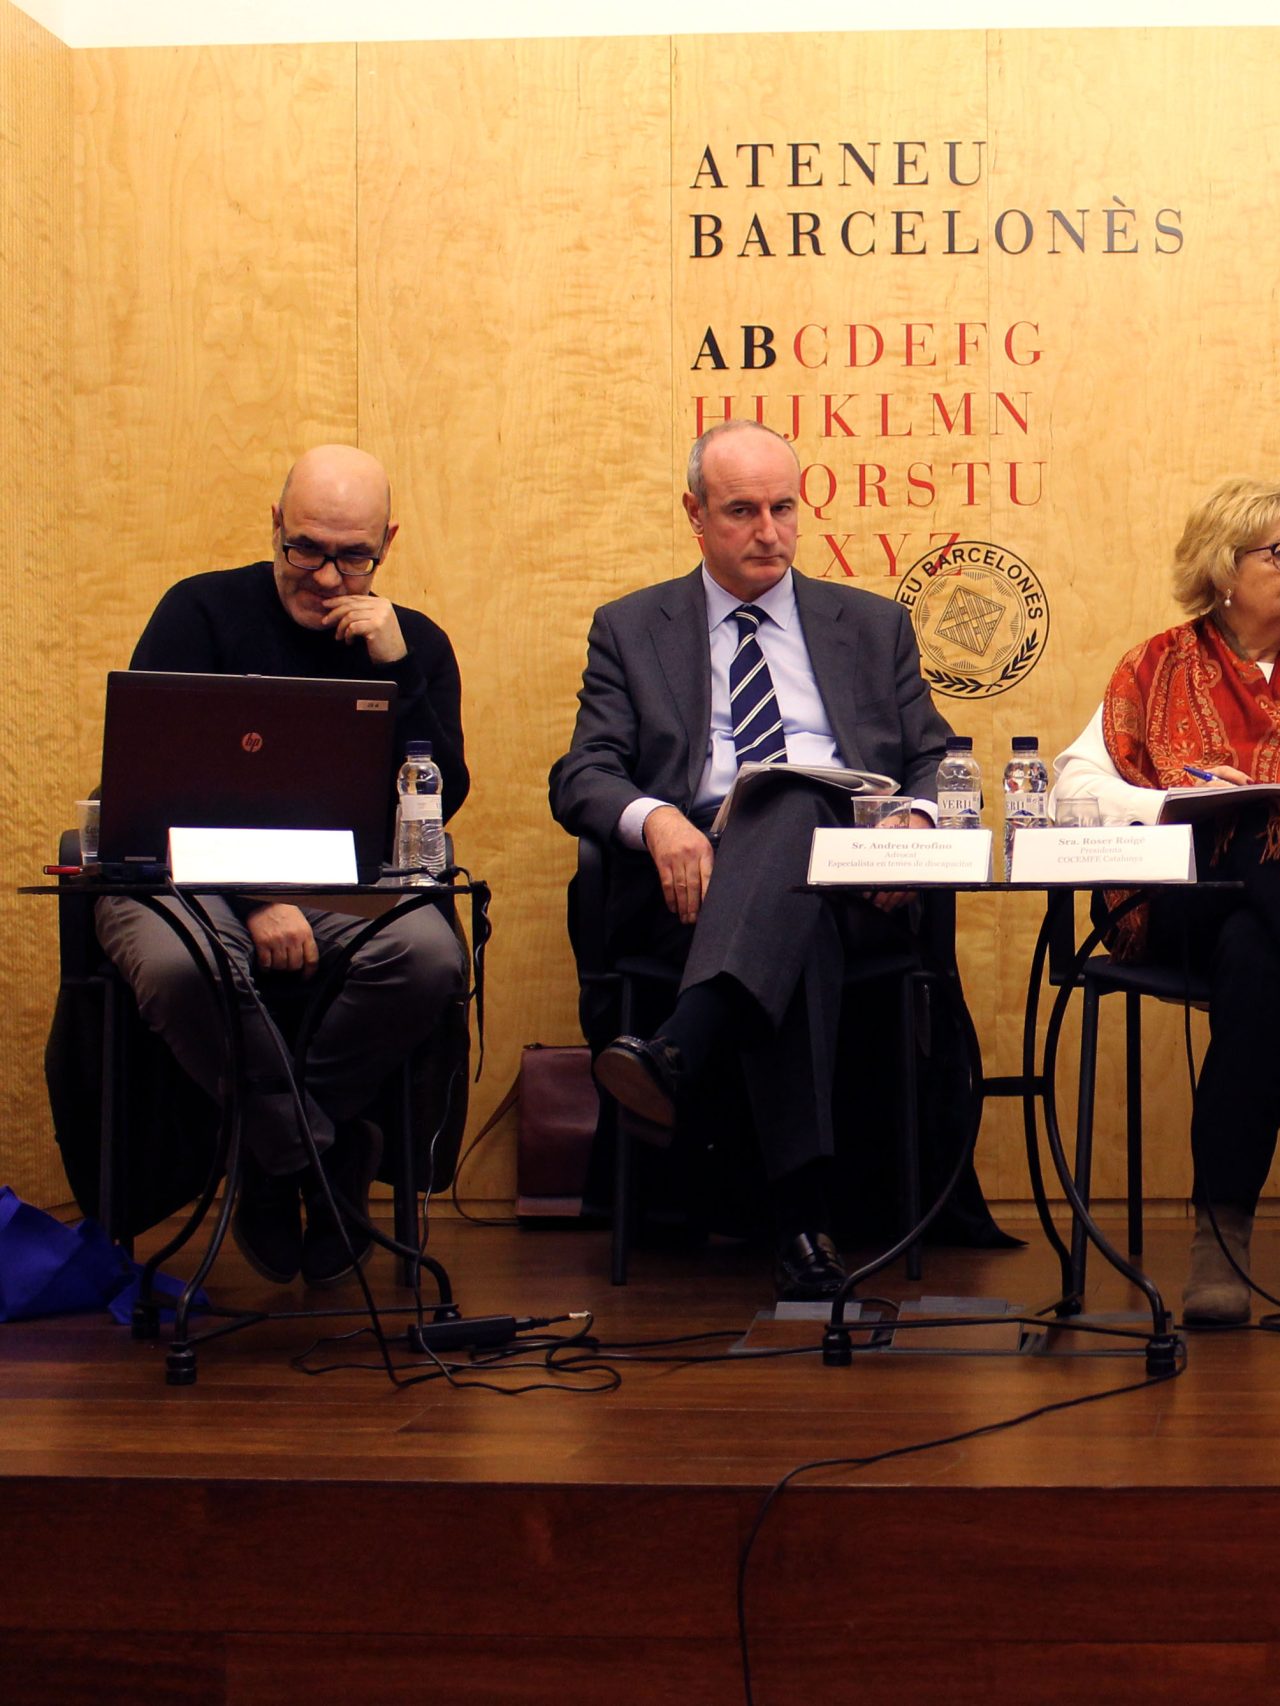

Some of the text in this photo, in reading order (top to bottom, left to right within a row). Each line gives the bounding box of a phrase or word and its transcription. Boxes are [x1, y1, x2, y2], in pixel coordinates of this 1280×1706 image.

[689, 141, 987, 188] ATENEU
[689, 196, 1185, 259] BARCELONÈS
[799, 461, 1048, 520] QRSTU
[921, 547, 1044, 621] BARCELONÈS
[243, 732, 262, 752] hp
[851, 841, 952, 850] Sr. Andreu Orofino
[1058, 838, 1080, 846] Sra.
[1082, 837, 1113, 846] Roser
[828, 859, 874, 869] Especialista
